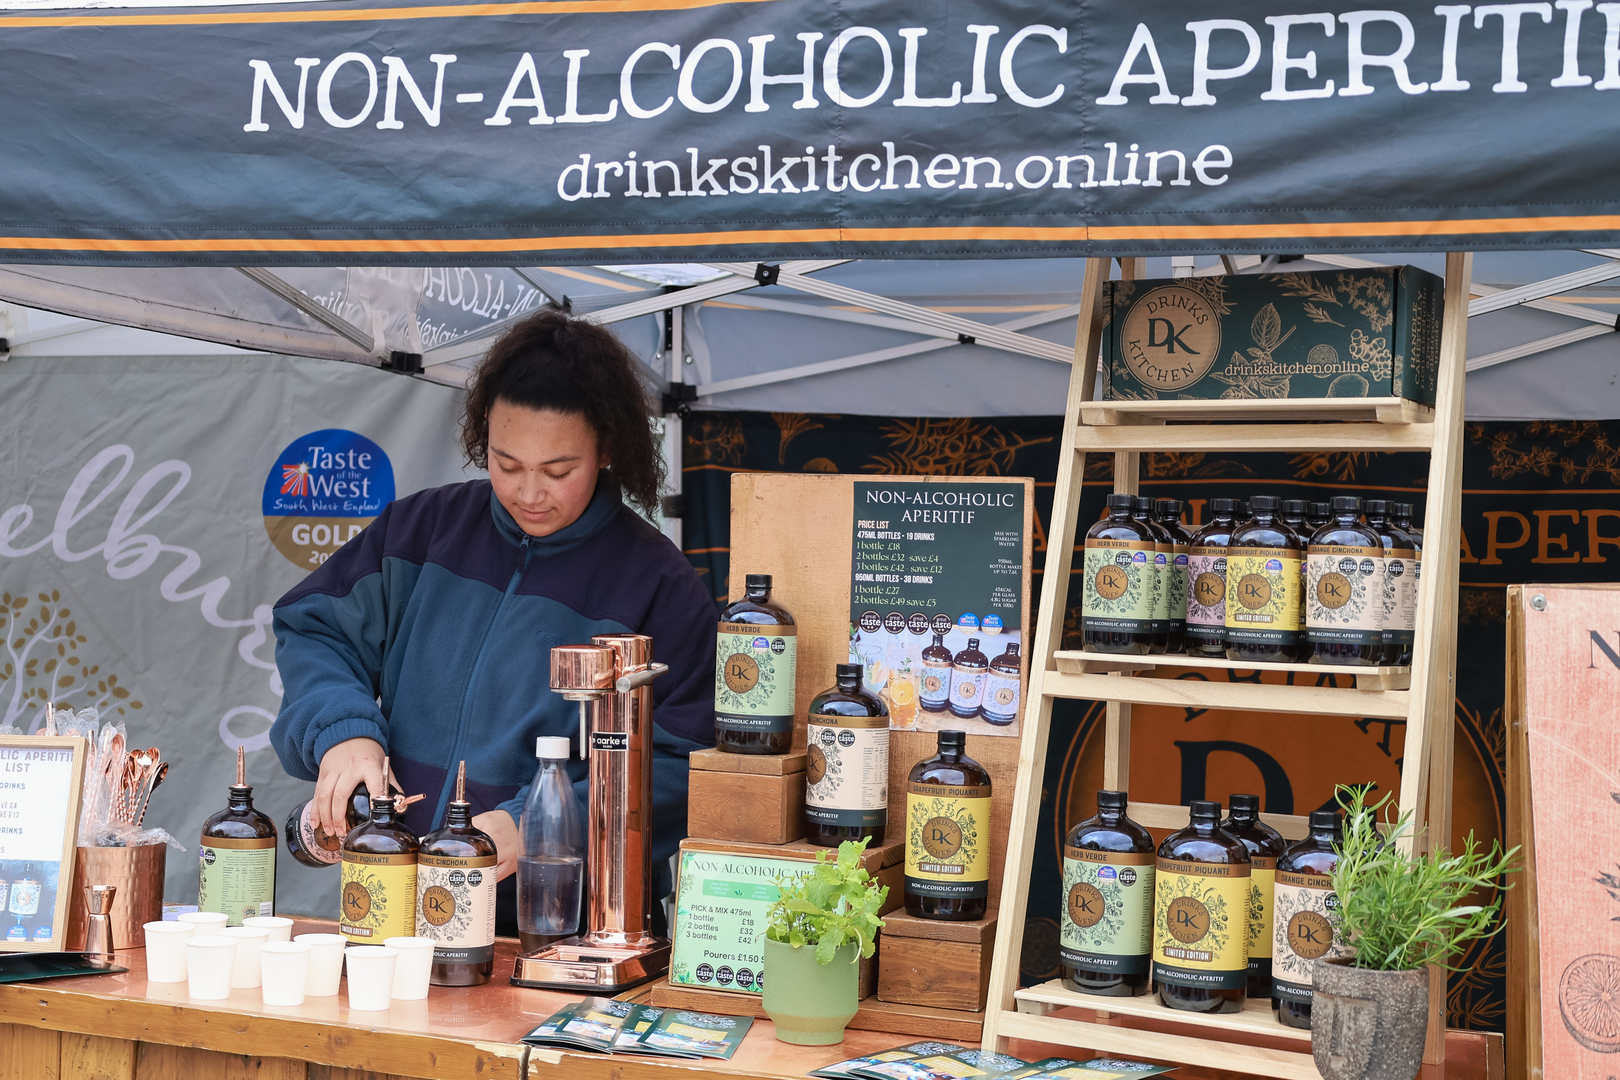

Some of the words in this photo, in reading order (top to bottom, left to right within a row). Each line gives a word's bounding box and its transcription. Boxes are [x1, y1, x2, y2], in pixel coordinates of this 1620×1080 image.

[244, 23, 1068, 133] NON-ALCOHOLIC
[556, 140, 1234, 202] drinkskitchen.online
[1146, 296, 1208, 326] DRINKS
[1147, 317, 1201, 355] DK
[1128, 339, 1195, 382] KITCHEN
[1224, 357, 1370, 377] drinkskitchen.online
[308, 446, 372, 469] Taste
[336, 471, 346, 479] of
[348, 471, 361, 479] the
[308, 474, 372, 498] West
[866, 490, 1014, 507] NON-ALCOHOLIC
[273, 498, 307, 511] South
[312, 499, 339, 511] West
[342, 499, 381, 514] England
[901, 509, 975, 523] APERITIF
[857, 520, 875, 529] PRICE
[876, 520, 889, 529] LIST
[857, 530, 876, 539] 475ML
[877, 531, 901, 540] BOTTLES
[906, 532, 913, 540] 19
[914, 532, 935, 541] DRINKS
[861, 541, 885, 550] bottle
[887, 542, 901, 551] £18
[1331, 547, 1364, 555] CINCHONA
[309, 553, 335, 567] 20
[855, 551, 861, 560] 2
[862, 551, 890, 561] bottles
[890, 553, 905, 562] £32
[928, 554, 939, 563] £4
[855, 562, 861, 571] 3
[861, 562, 888, 571] bottles
[889, 563, 905, 572] £42
[929, 565, 943, 574] £12
[855, 573, 875, 582] 950ML
[875, 574, 900, 583] BOTTLES
[903, 575, 912, 583] 38
[912, 575, 933, 584] DRINKS
[1103, 574, 1122, 589] DK
[859, 585, 884, 594] bottle
[885, 586, 900, 595] £27
[1201, 581, 1218, 596] DK
[1245, 583, 1264, 598] DK
[1324, 582, 1344, 597] DK
[854, 595, 860, 604] 2
[860, 595, 889, 605] bottles
[889, 597, 905, 606] £49
[925, 598, 937, 608] £5
[861, 618, 881, 626] taste
[885, 619, 905, 627] taste
[908, 620, 929, 628] taste
[932, 621, 951, 629] taste
[731, 664, 751, 681] DK
[597, 736, 620, 745] aarke
[5, 762, 31, 773] LIST
[913, 785, 947, 795] GRAPEFRUIT
[949, 788, 979, 796] PIQUANTE
[0, 827, 23, 835] RINKS
[932, 828, 954, 845] DK
[359, 855, 390, 863] PIQUANTE
[436, 858, 468, 867] CINCHONA
[1070, 850, 1084, 859] HERB
[1085, 852, 1108, 862] VERDE
[693, 860, 790, 879] NON-ALCOHOLIC
[921, 863, 940, 872] LIMITED
[941, 865, 962, 873] EDITION
[1158, 861, 1192, 873] GRAPEFRUIT
[1195, 865, 1231, 875] PIQUANTE
[1120, 873, 1136, 881] taste
[1281, 874, 1305, 885] ORANGE
[1307, 878, 1335, 888] CINCH
[911, 882, 952, 892] NON-ALCOHOLIC
[347, 892, 363, 910] DK
[429, 896, 448, 914] DK
[1075, 894, 1096, 915] DK
[691, 904, 707, 913] PICK
[730, 908, 752, 916] 475ml
[693, 914, 715, 922] bottle
[741, 918, 755, 926] £18
[1176, 909, 1201, 929] DK
[1297, 914, 1328, 931] DRINKS
[685, 930, 691, 938] 3
[692, 931, 717, 941] bottles
[693, 923, 719, 932] bottles
[739, 927, 754, 936] £32
[1298, 923, 1324, 945] DK
[703, 949, 736, 961] Pourers
[737, 954, 759, 963] £1.50
[1165, 947, 1186, 959] LIMITED
[1186, 949, 1209, 961] EDITION
[1093, 957, 1118, 967] APERITIF
[737, 974, 754, 982] taste
[1156, 968, 1198, 981] NON-ALCOHOLIC
[1198, 974, 1224, 982] APERITIF
